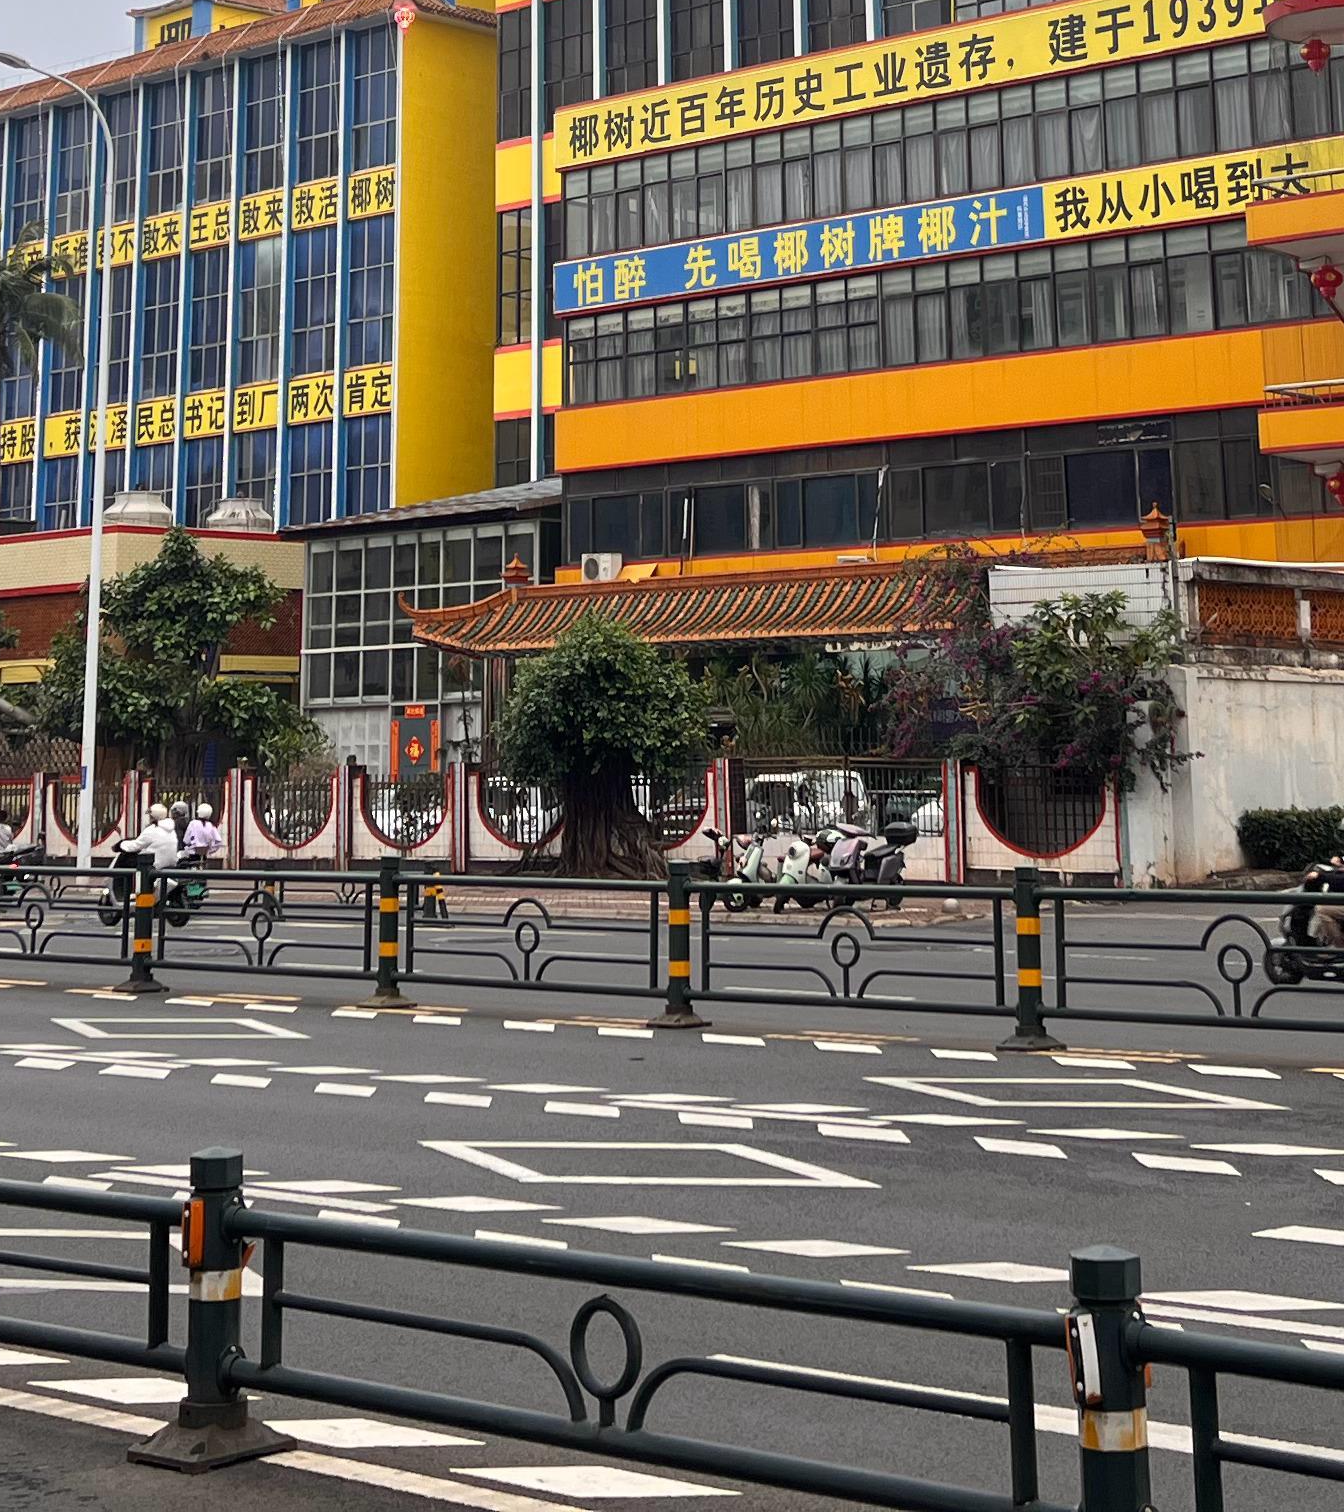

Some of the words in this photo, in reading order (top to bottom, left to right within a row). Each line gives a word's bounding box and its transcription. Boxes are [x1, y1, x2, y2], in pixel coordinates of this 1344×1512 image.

[1055, 152, 1311, 233] 我从小喝到大
[573, 254, 647, 307] 怕醉
[683, 197, 1008, 289] 先喝椰树牌椰汁
